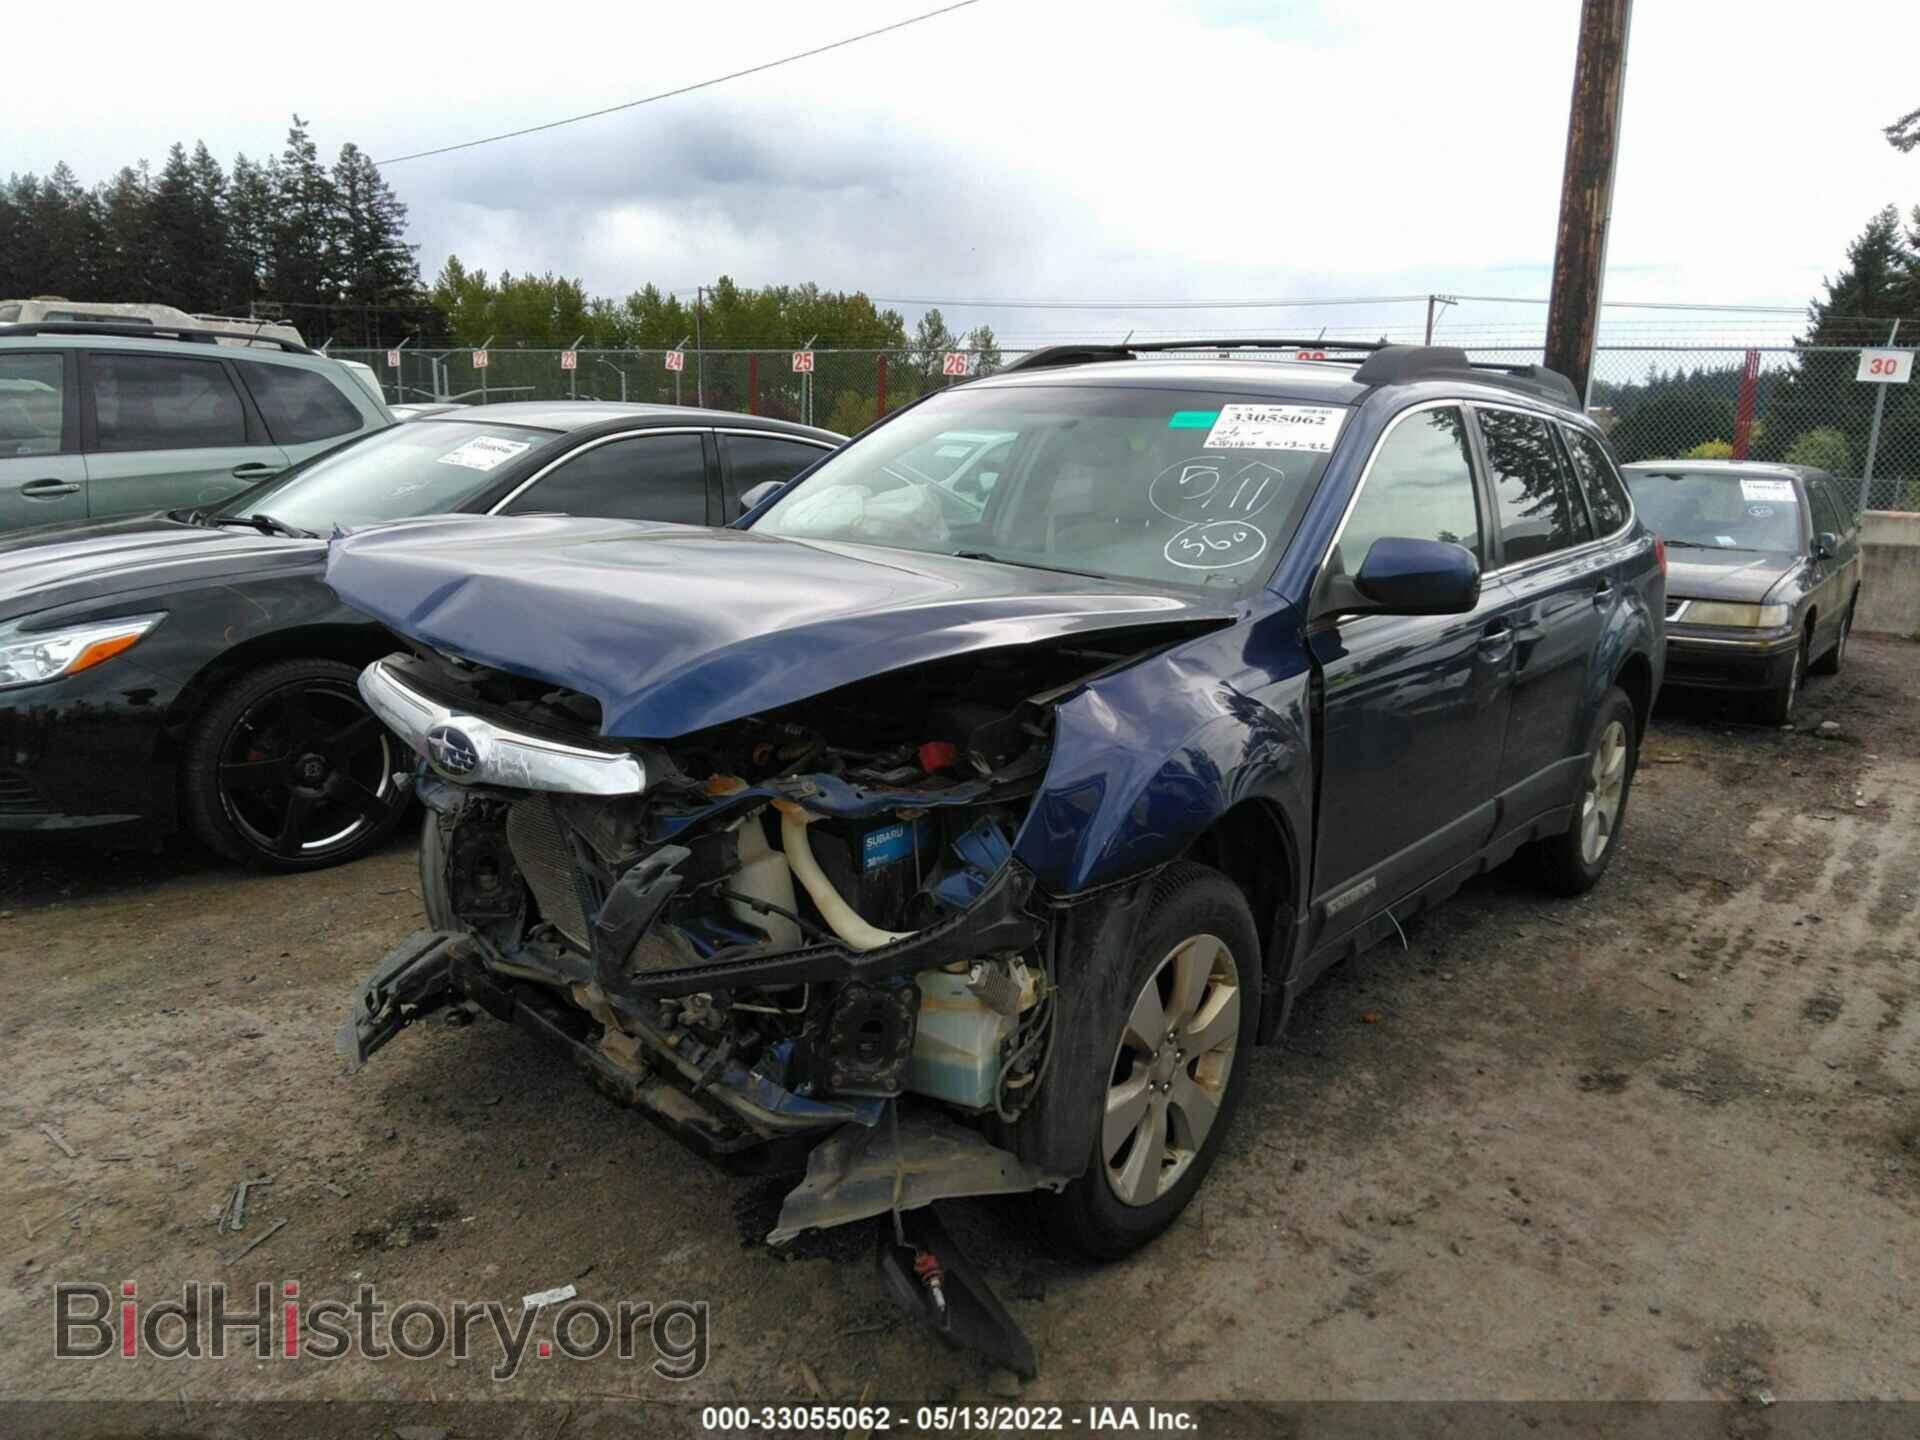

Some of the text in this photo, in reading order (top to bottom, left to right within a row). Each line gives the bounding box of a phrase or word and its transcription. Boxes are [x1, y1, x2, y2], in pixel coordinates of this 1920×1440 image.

[474, 351, 487, 367] 22
[562, 352, 576, 369] 23
[667, 352, 683, 370] 24
[794, 352, 812, 370] 25
[945, 354, 965, 374] 26
[1870, 358, 1897, 375] 30
[1233, 413, 1327, 425] 33055062
[865, 826, 904, 849] SUBARU
